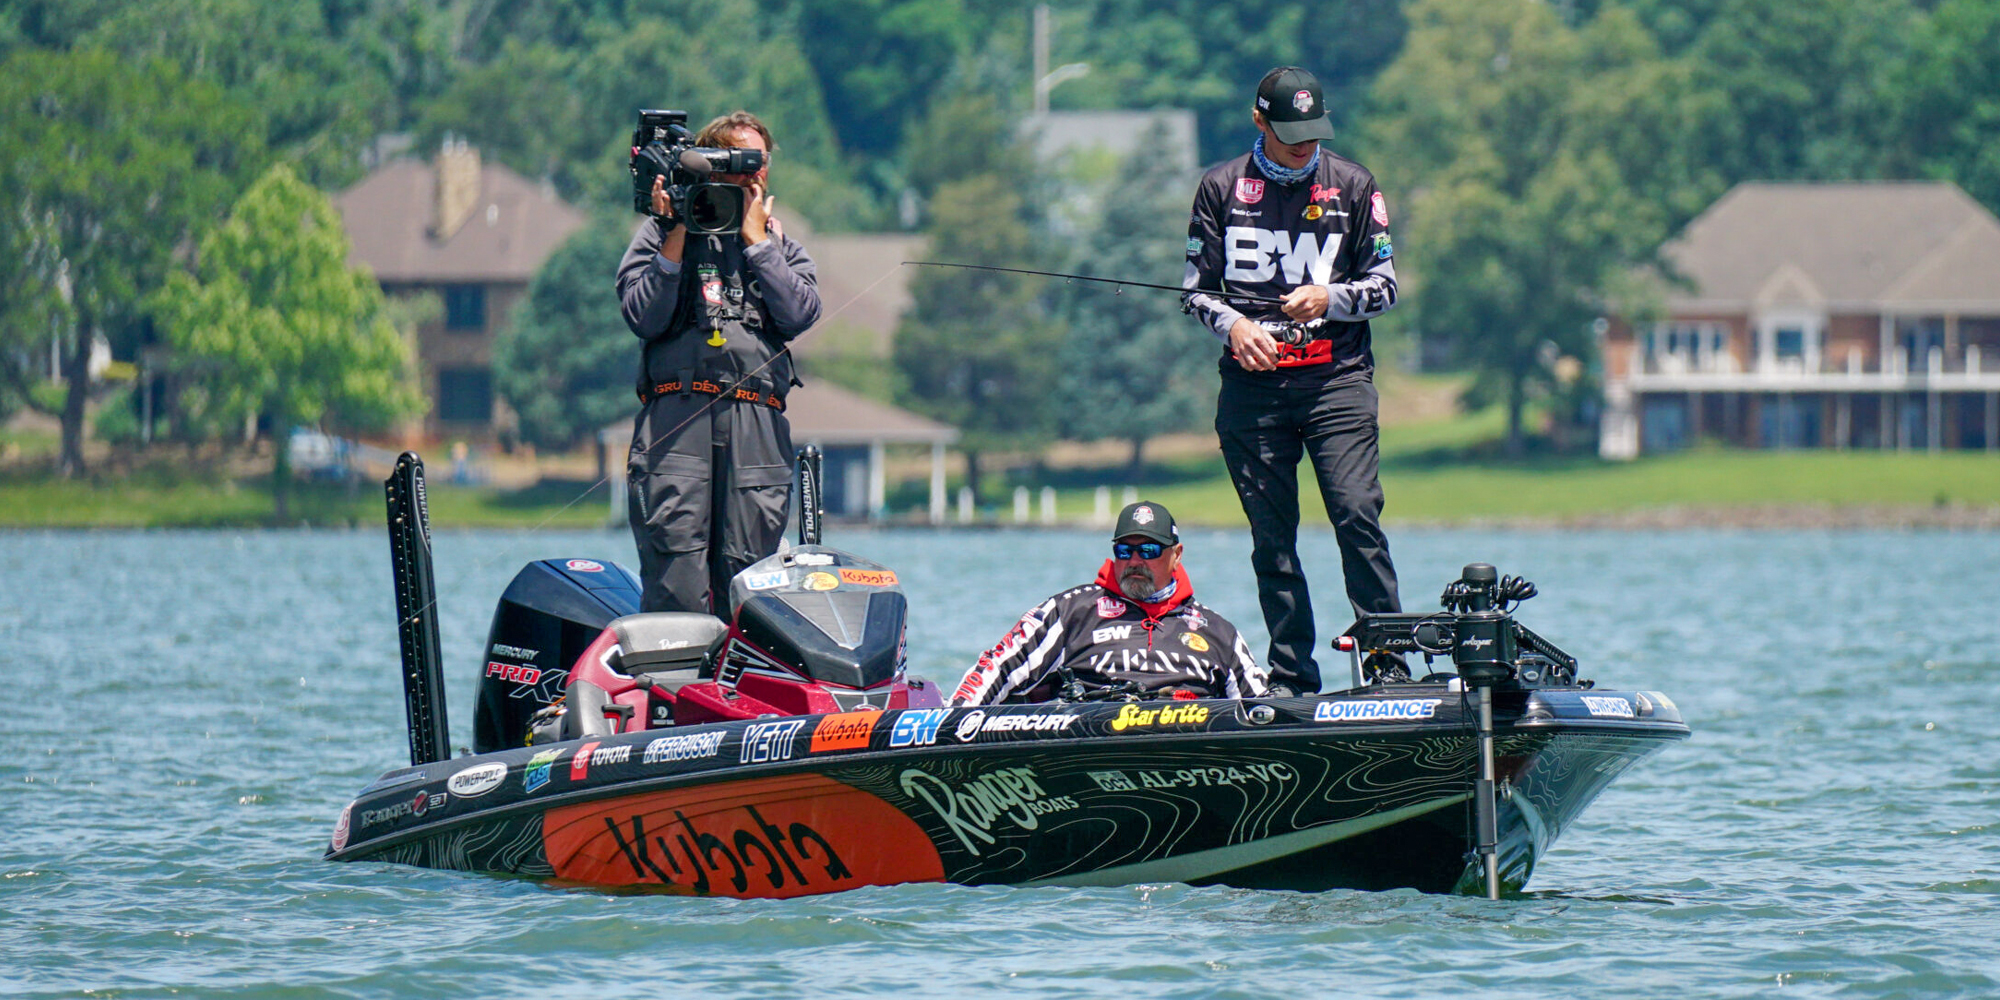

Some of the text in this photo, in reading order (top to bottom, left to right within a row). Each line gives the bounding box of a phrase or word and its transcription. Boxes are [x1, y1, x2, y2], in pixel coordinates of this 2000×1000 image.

[1224, 226, 1343, 286] BW
[802, 470, 815, 540] POWER-POLE
[842, 571, 895, 583] Kubota
[1101, 596, 1122, 610] MLF
[1092, 624, 1132, 645] BW
[492, 643, 541, 660] MERCURY
[485, 661, 541, 685] PRO
[1112, 704, 1209, 732] Star brite
[1315, 698, 1441, 722] LOWRANCE
[1581, 696, 1634, 718] LOWRANCE
[817, 715, 870, 743] Kubota
[889, 707, 954, 748] BW
[983, 713, 1080, 732] MERCURY
[740, 720, 806, 764] YETI
[591, 745, 633, 766] TOYOTA
[455, 770, 503, 789] POWER-POLE
[1100, 778, 1134, 791] OCT
[1138, 763, 1292, 788] AL-9724-VC
[361, 798, 414, 829] Ranger
[900, 767, 1046, 856] Ranger
[1027, 796, 1080, 816] BOATS
[604, 804, 853, 894] Kubota
